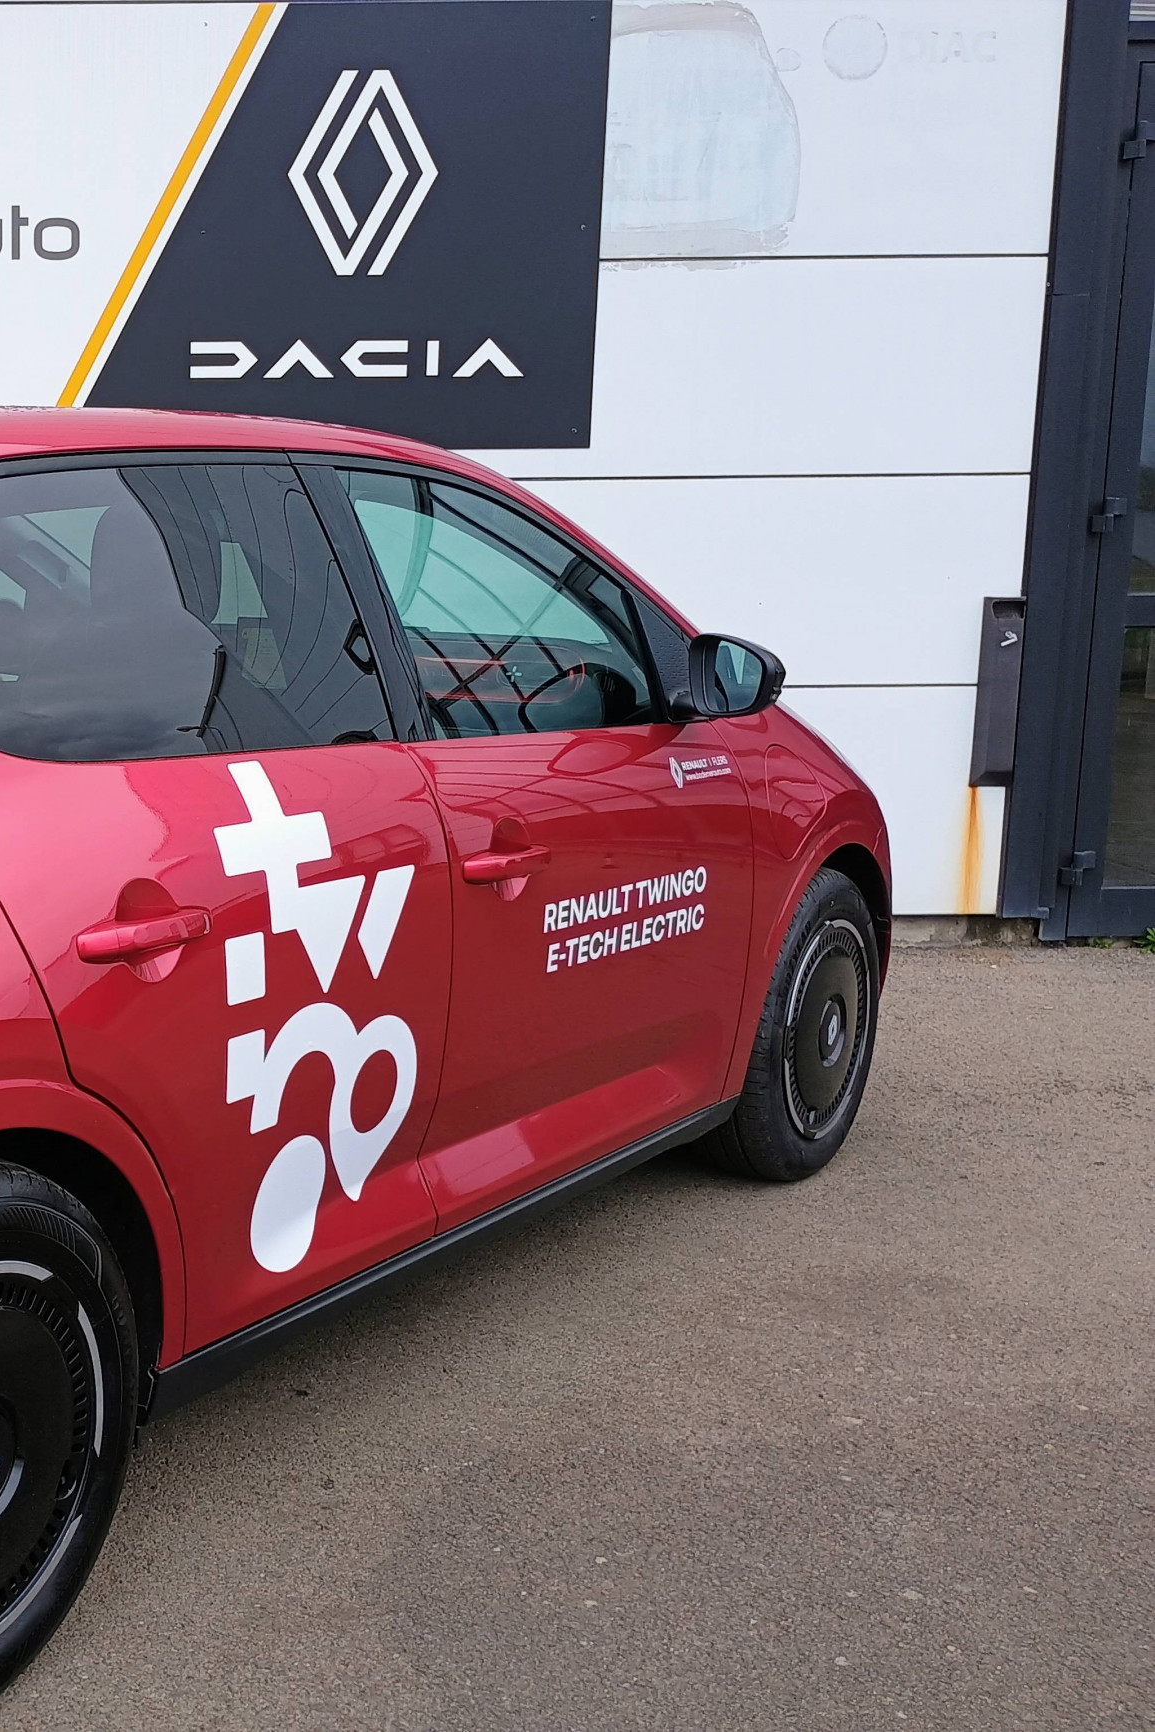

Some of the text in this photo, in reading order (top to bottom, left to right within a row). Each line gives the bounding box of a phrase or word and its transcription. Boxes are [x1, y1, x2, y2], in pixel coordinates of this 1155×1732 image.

[189, 338, 525, 379] DACIA
[681, 759, 707, 770] RENAULT
[543, 865, 708, 934] RENAULT TWINGO
[546, 903, 706, 974] E-TECH ELECTRIC
